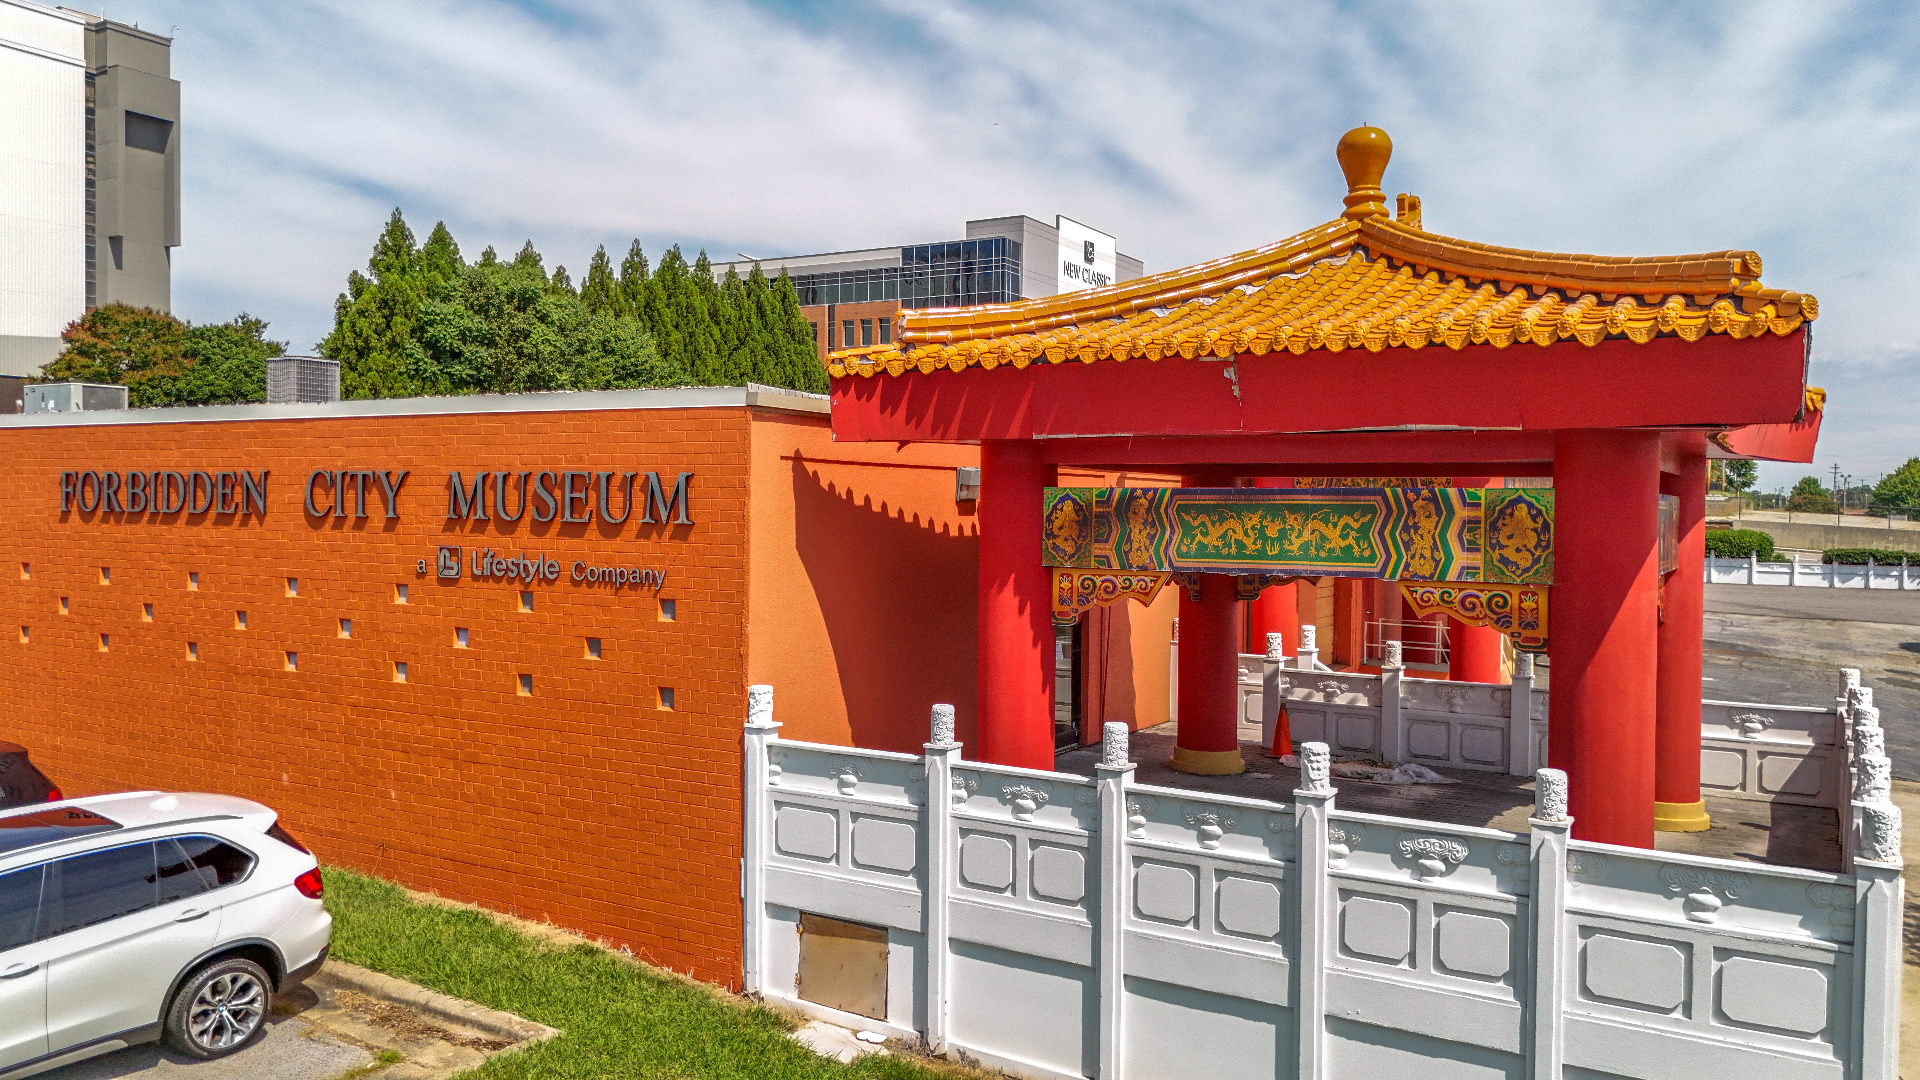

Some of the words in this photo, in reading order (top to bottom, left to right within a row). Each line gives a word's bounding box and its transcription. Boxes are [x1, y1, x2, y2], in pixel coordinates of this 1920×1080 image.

[1063, 260, 1081, 280] NEW
[59, 469, 271, 515] FORBIDDEN
[304, 469, 411, 519] CITY
[445, 471, 695, 525] MUSEUM
[416, 559, 427, 573] a
[471, 547, 560, 583] Lifestyle
[571, 561, 666, 590] Company
